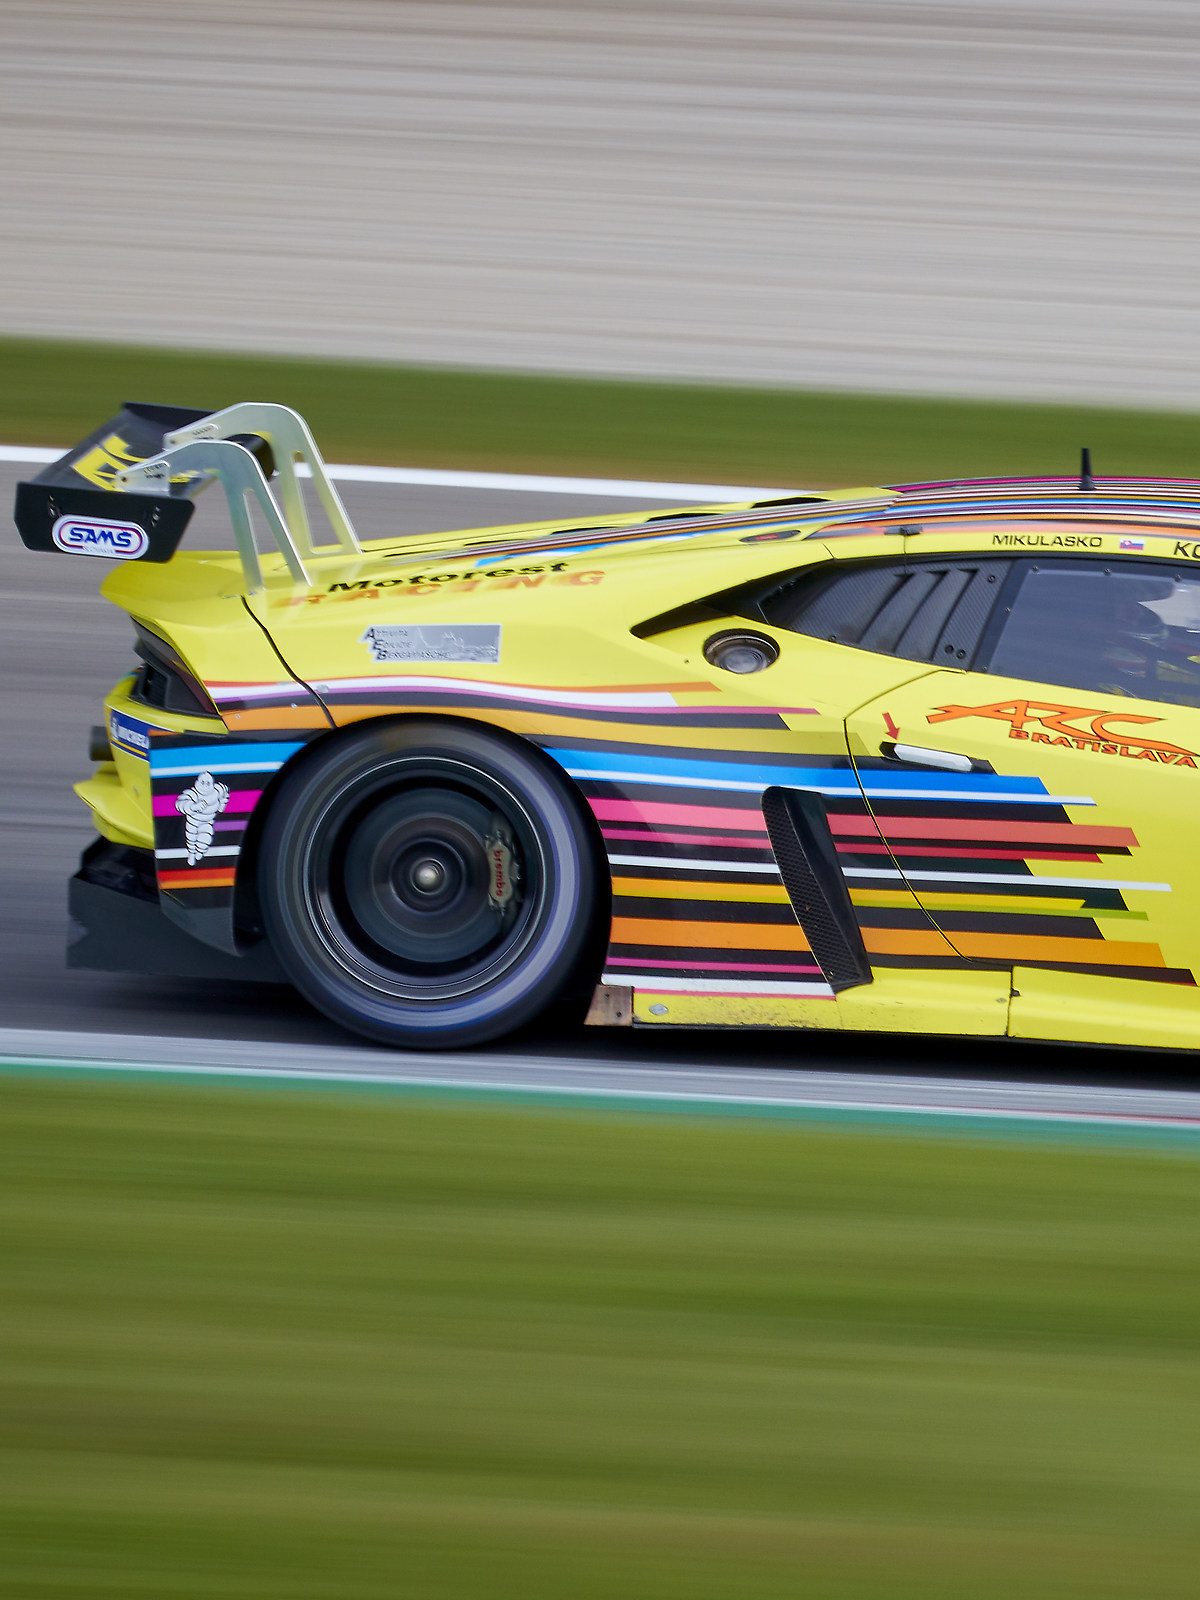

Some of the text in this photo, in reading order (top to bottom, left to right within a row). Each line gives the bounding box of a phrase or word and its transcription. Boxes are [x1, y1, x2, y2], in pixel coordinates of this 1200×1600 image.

[992, 535, 1102, 547] MIKULASKO
[275, 570, 605, 607] RACING
[328, 562, 568, 592] Motorest
[1009, 728, 1199, 769] BRATISLAVA
[494, 850, 505, 896] brembo
